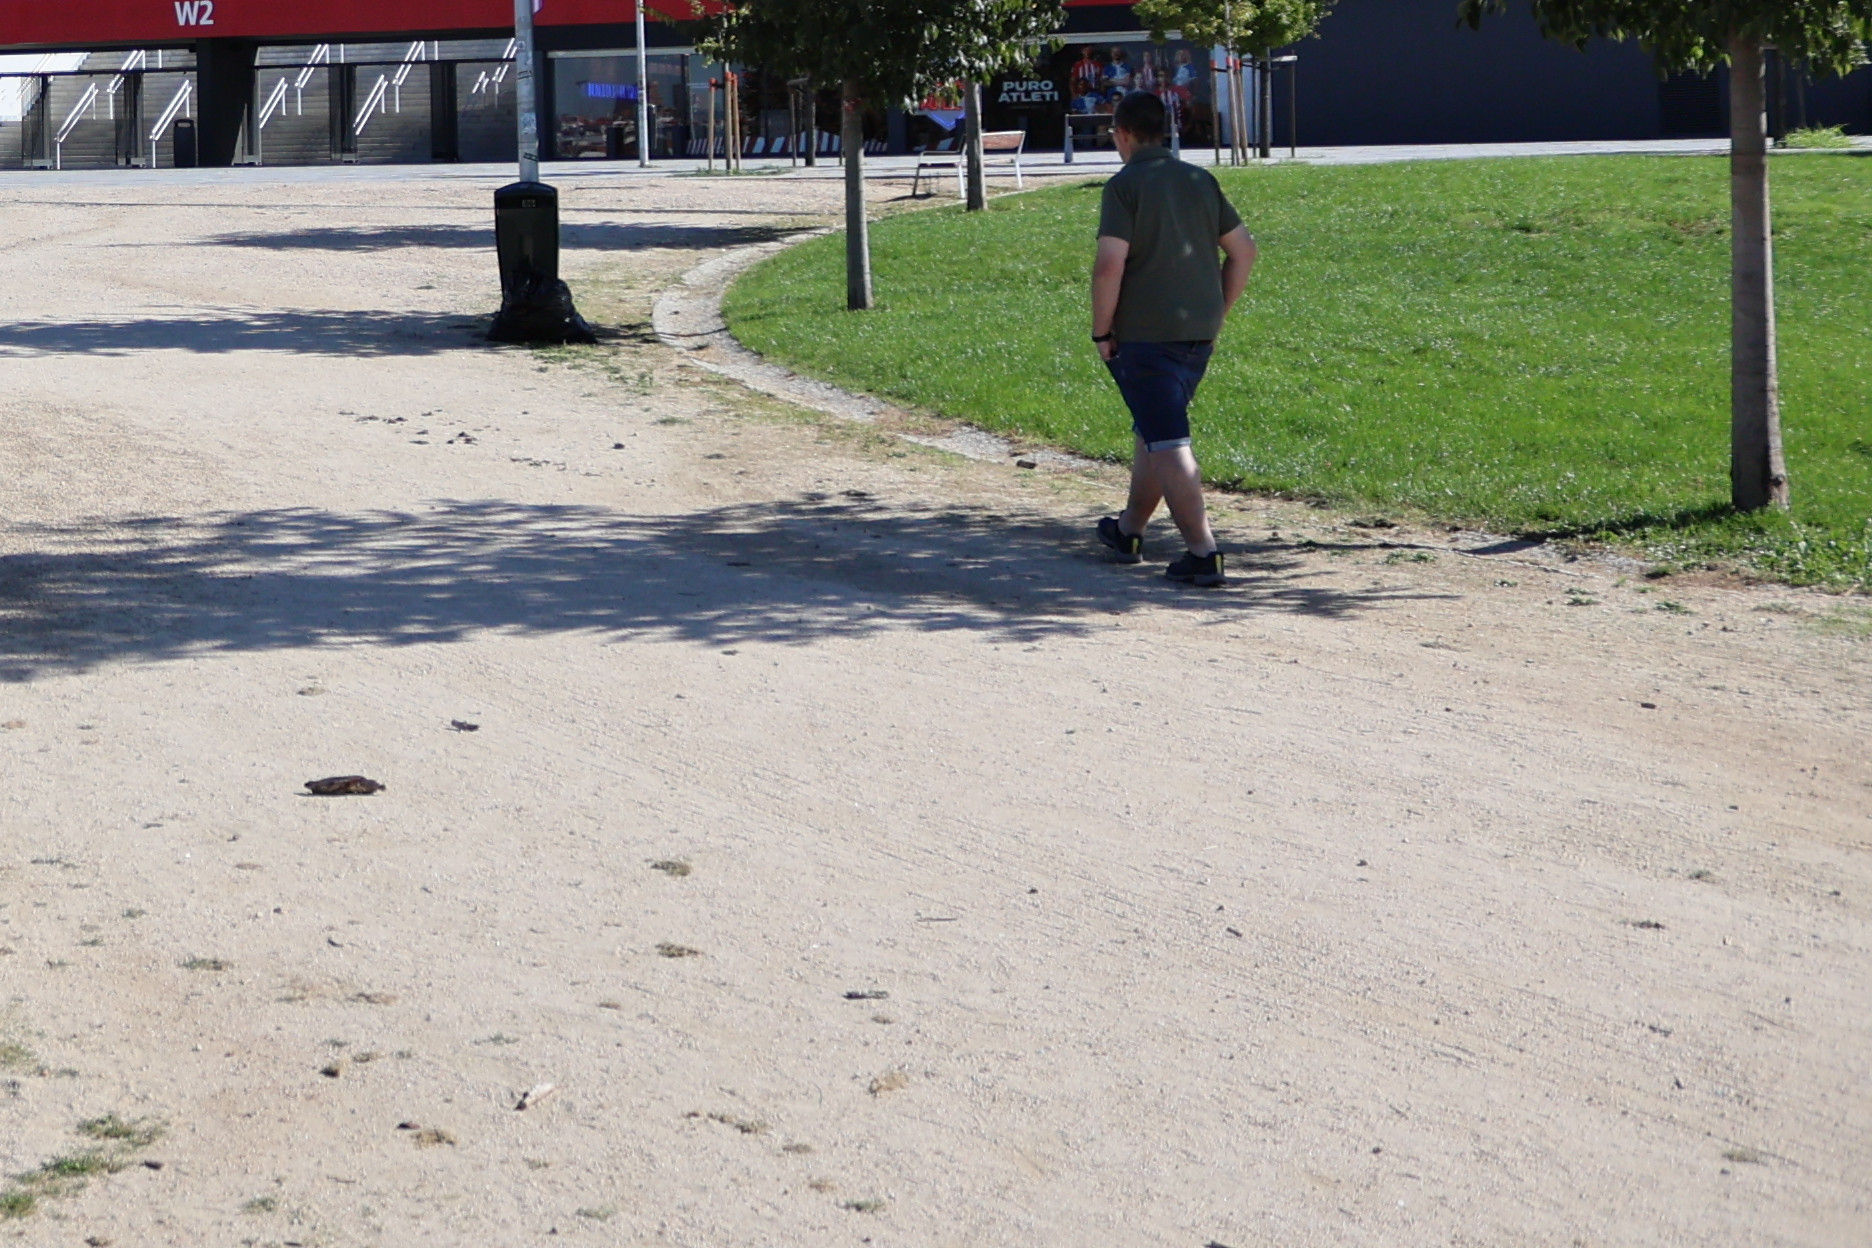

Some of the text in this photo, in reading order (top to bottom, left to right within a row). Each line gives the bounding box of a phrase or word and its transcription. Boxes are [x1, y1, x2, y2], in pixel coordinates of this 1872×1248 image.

[174, 0, 215, 26] W2
[1003, 80, 1054, 91] PURO
[998, 91, 1059, 103] ATLETI
